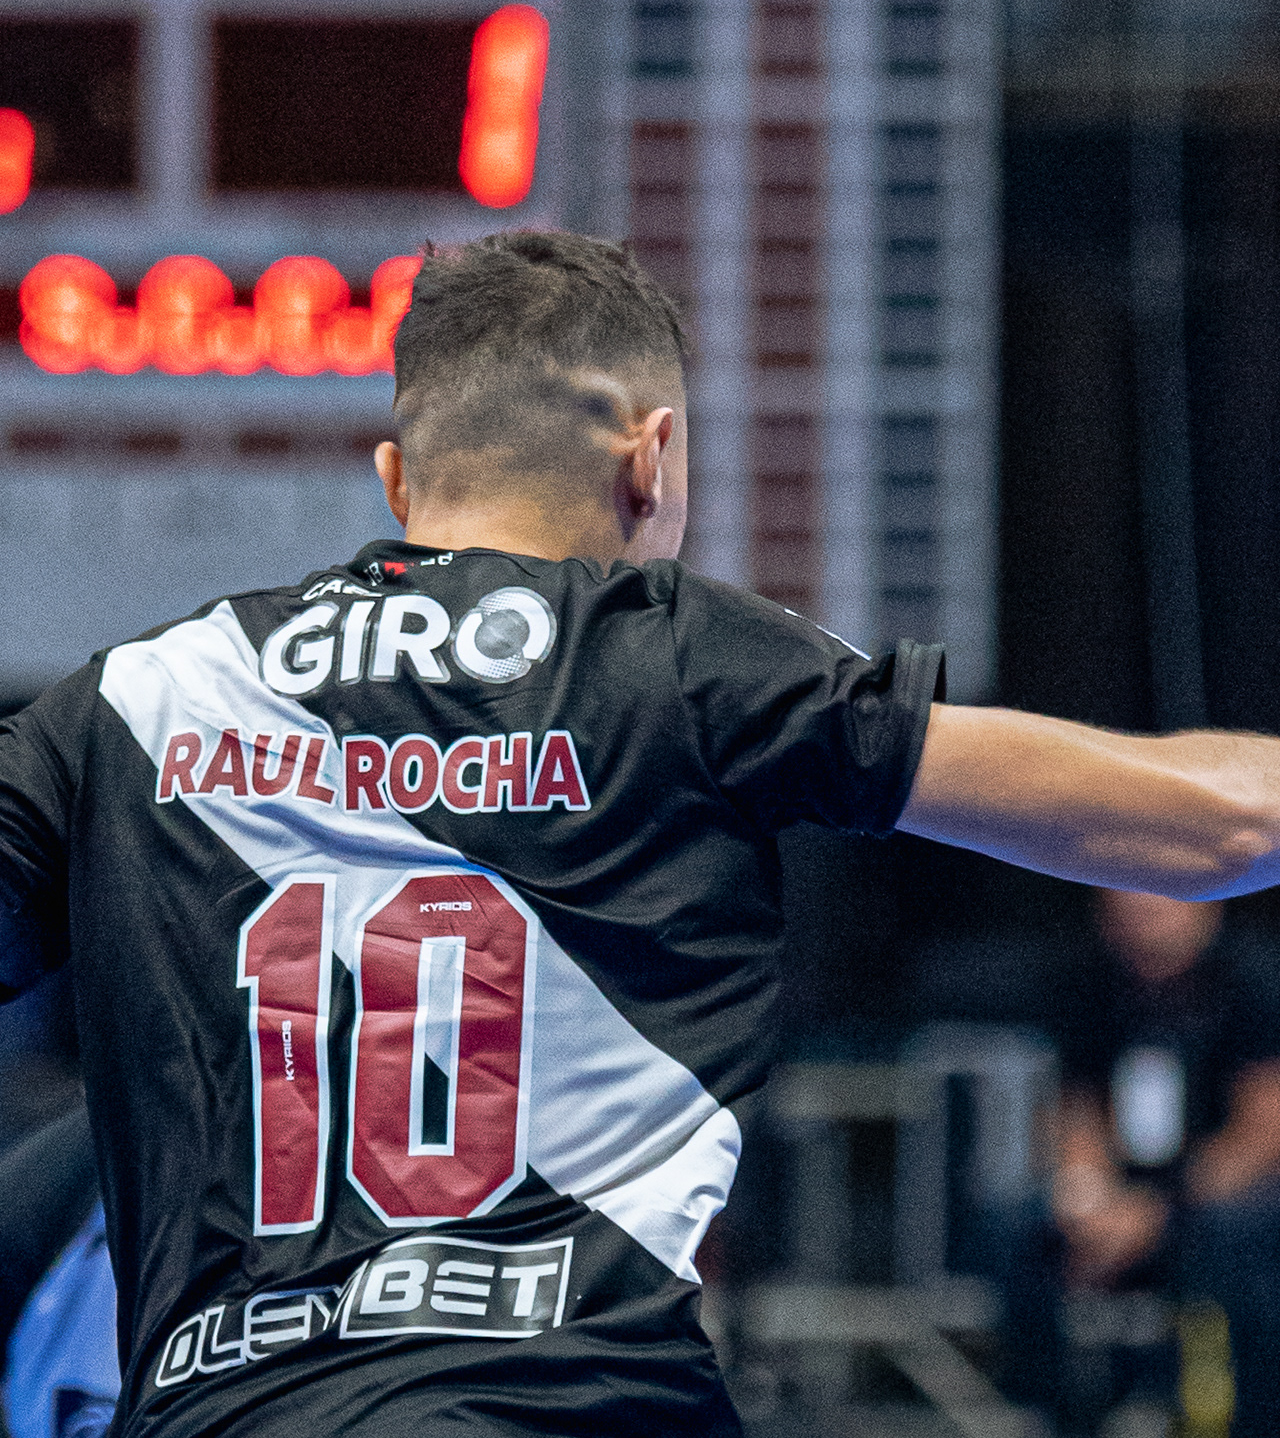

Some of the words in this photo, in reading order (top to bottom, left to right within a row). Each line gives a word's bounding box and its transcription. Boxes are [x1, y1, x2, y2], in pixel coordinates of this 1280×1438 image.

[457, 2, 551, 209] 1
[261, 586, 556, 696] GIRO
[156, 725, 338, 805] RAUL
[341, 730, 591, 814] ROCHA
[420, 901, 472, 913] KYRIOS
[237, 874, 538, 1237] 10
[281, 1020, 295, 1081] KYRIOS
